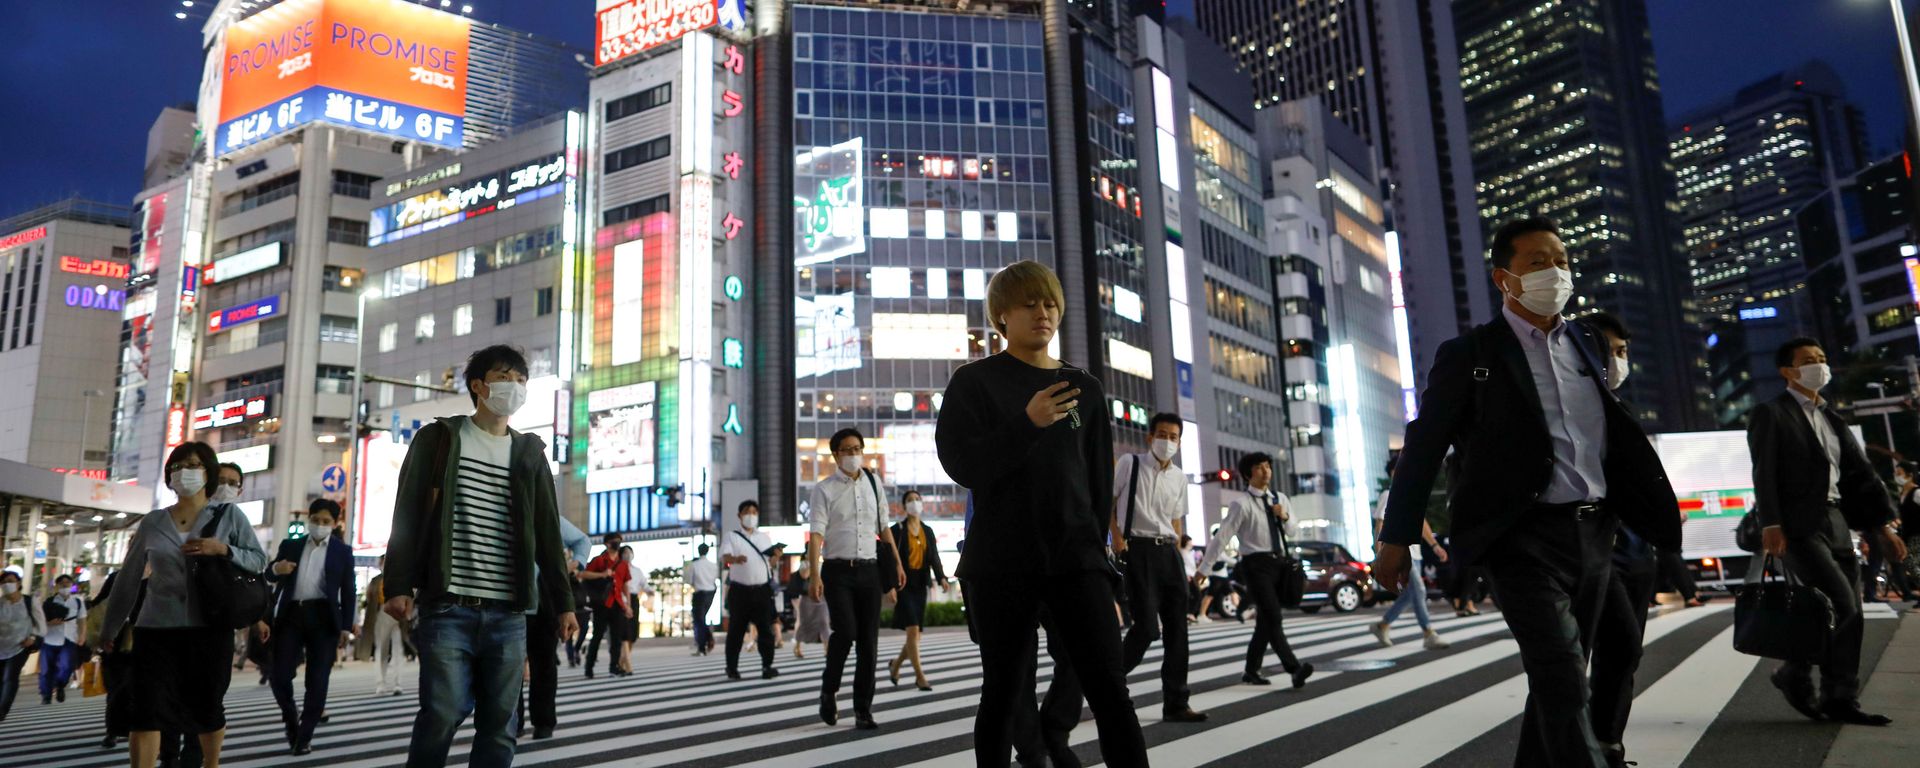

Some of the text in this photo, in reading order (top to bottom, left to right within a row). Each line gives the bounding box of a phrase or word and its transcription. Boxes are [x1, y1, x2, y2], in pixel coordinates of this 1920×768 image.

[229, 20, 314, 80] PROMISE
[331, 22, 457, 73] PROMISE
[600, 3, 714, 62] 03-3345-6430
[278, 52, 312, 78] プロミス
[409, 66, 456, 90] プロミス
[226, 97, 303, 147] 当ビル 6F
[324, 92, 454, 140] 当ビル 6F
[65, 285, 126, 311] ODAK
